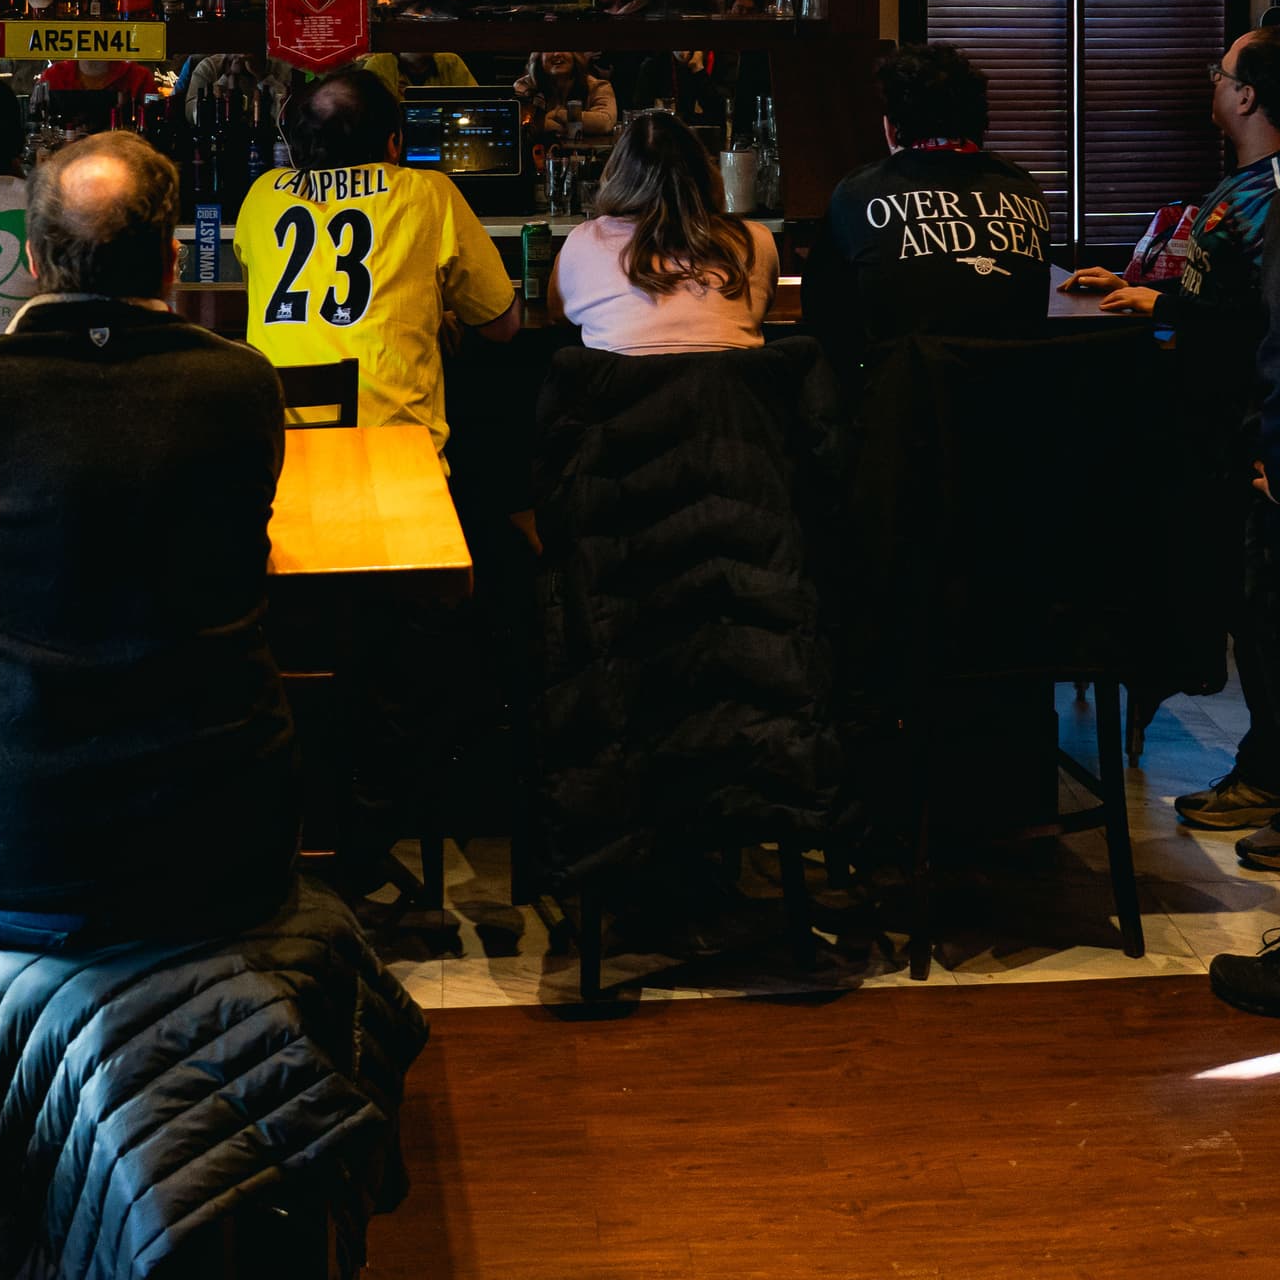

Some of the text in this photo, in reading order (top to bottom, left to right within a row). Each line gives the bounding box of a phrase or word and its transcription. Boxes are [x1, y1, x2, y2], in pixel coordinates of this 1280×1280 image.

[273, 168, 390, 203] CAMPBELL
[196, 210, 218, 219] CIDER
[866, 190, 1050, 232] OVER LAND
[898, 220, 1045, 262] AND SEA
[264, 204, 375, 327] 23
